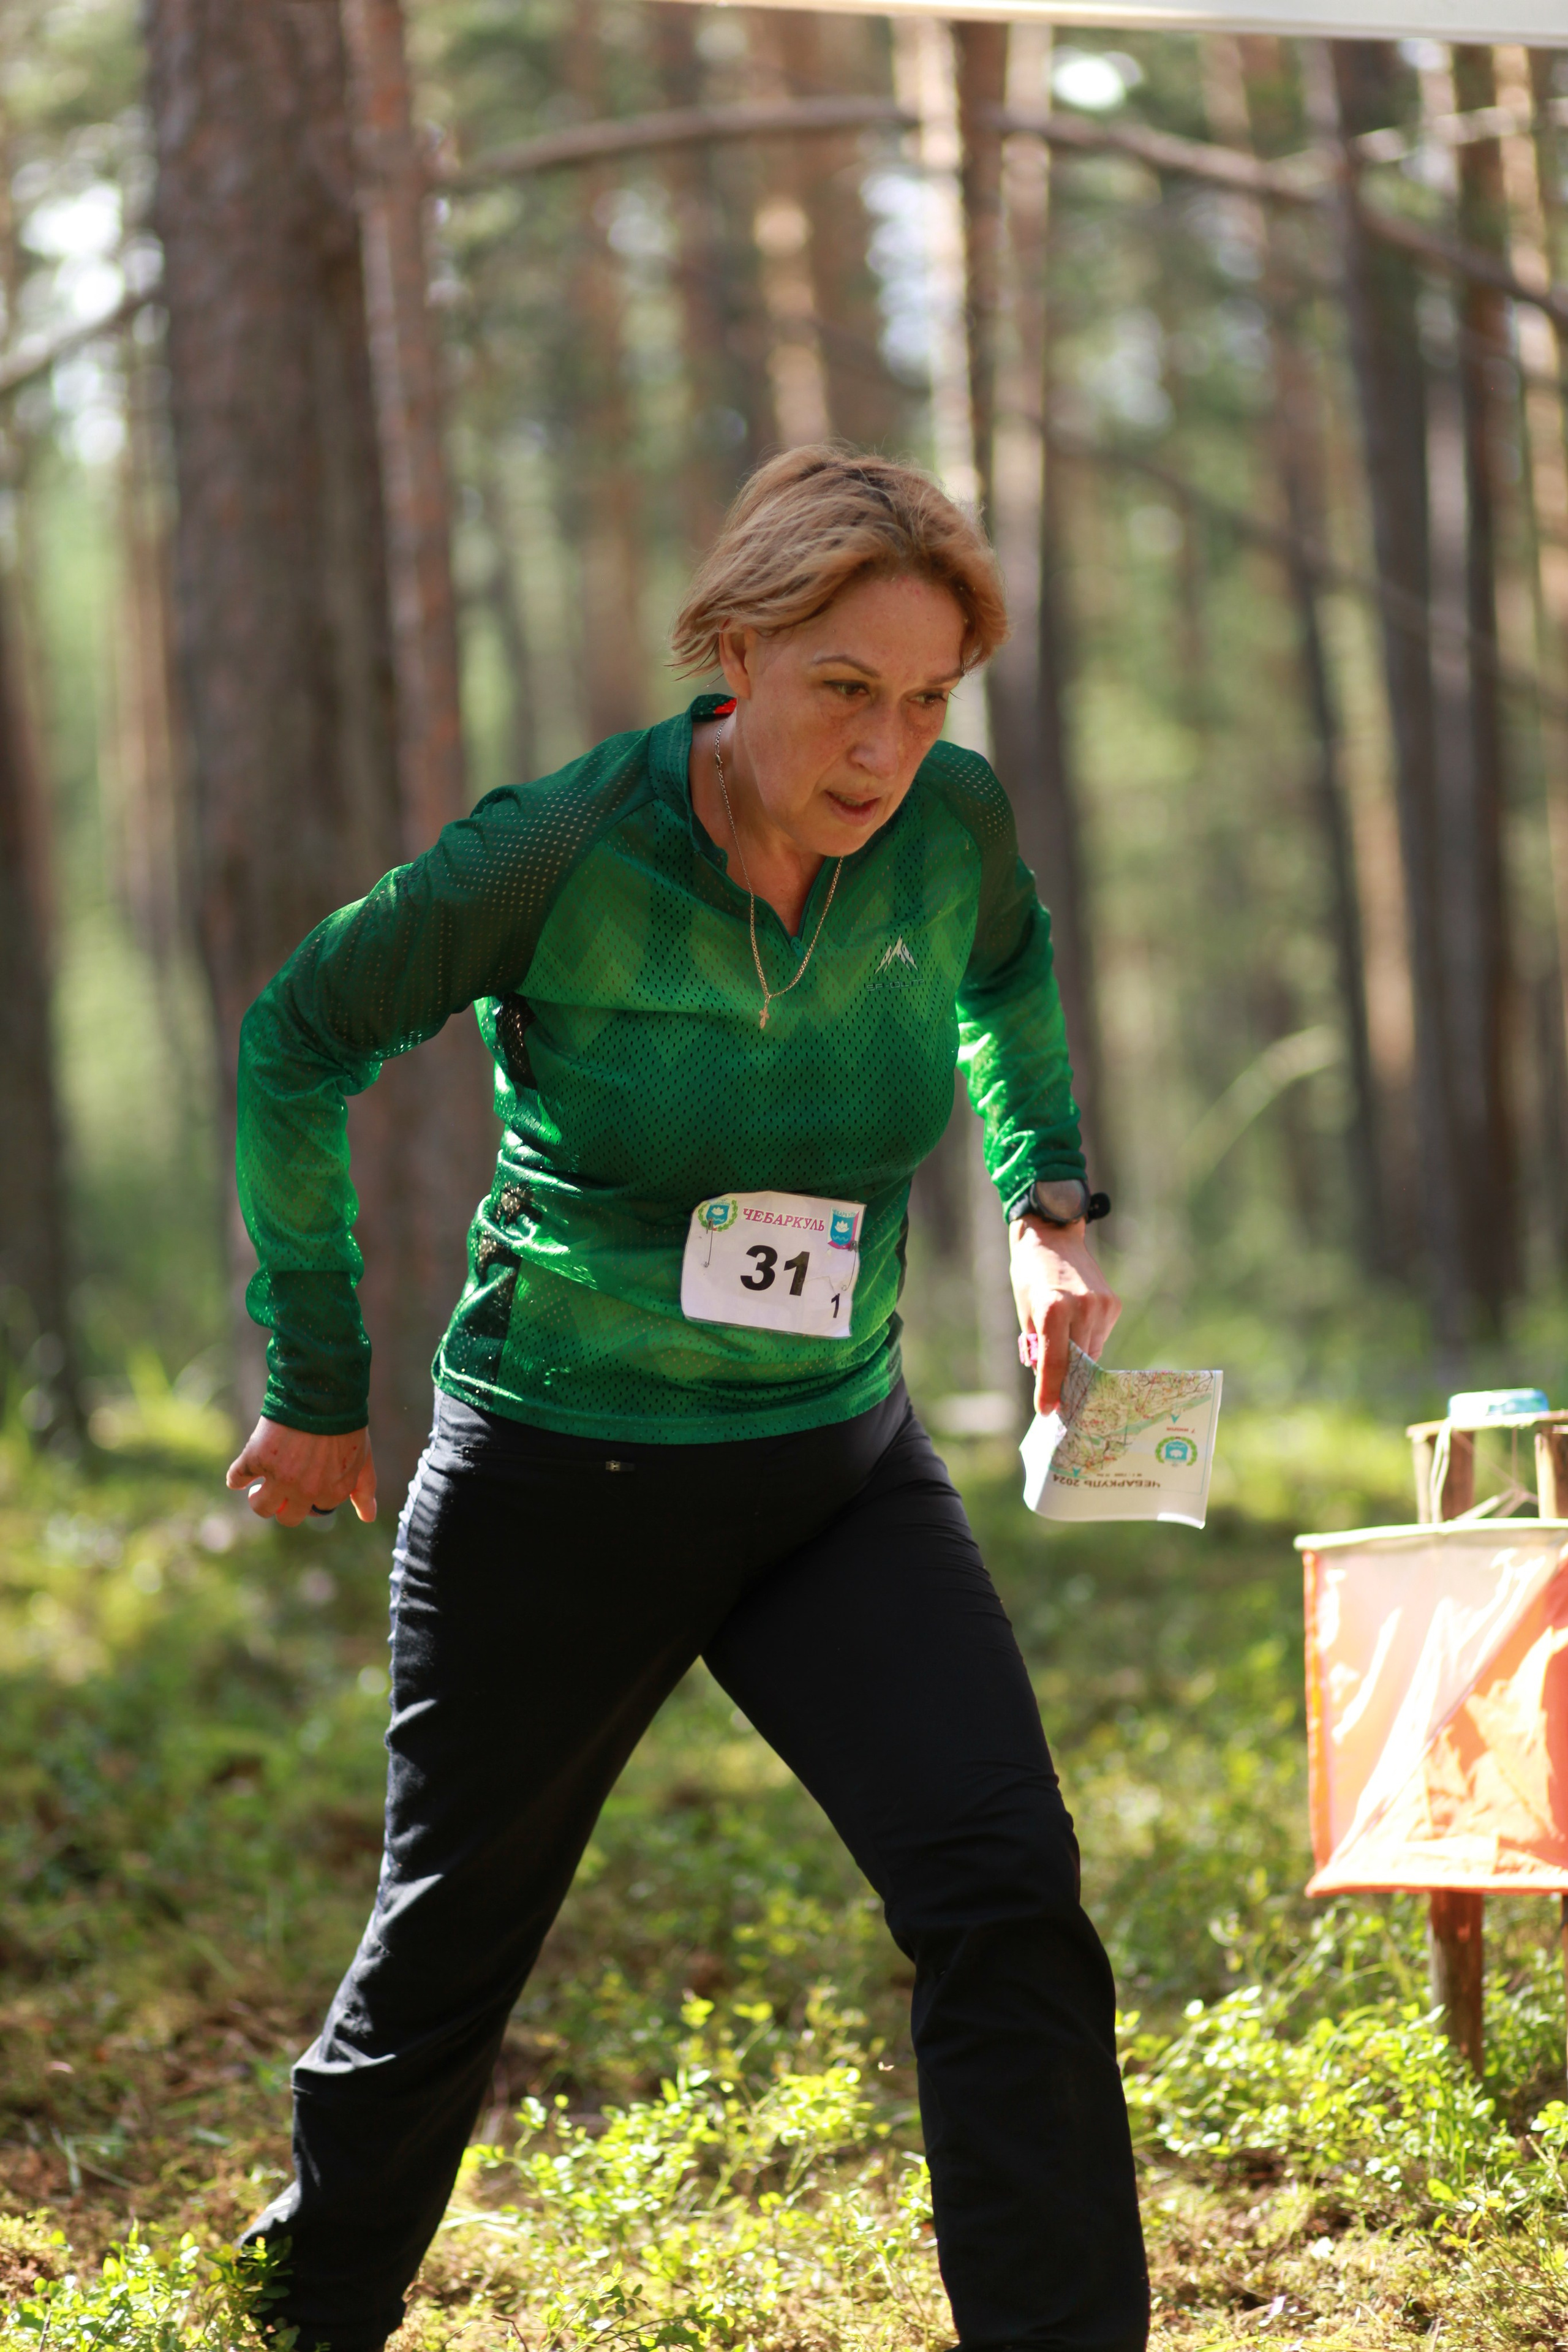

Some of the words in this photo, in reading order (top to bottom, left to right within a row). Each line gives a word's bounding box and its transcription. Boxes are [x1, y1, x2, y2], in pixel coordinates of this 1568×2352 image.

[743, 1208, 825, 1232] ЧЕБАРКУЛЬ
[740, 1245, 810, 1296] 31
[831, 1293, 840, 1318] 1
[1053, 1474, 1080, 1487] 2024
[1084, 1479, 1161, 1488] ЧЕБАРКУЛЬ
